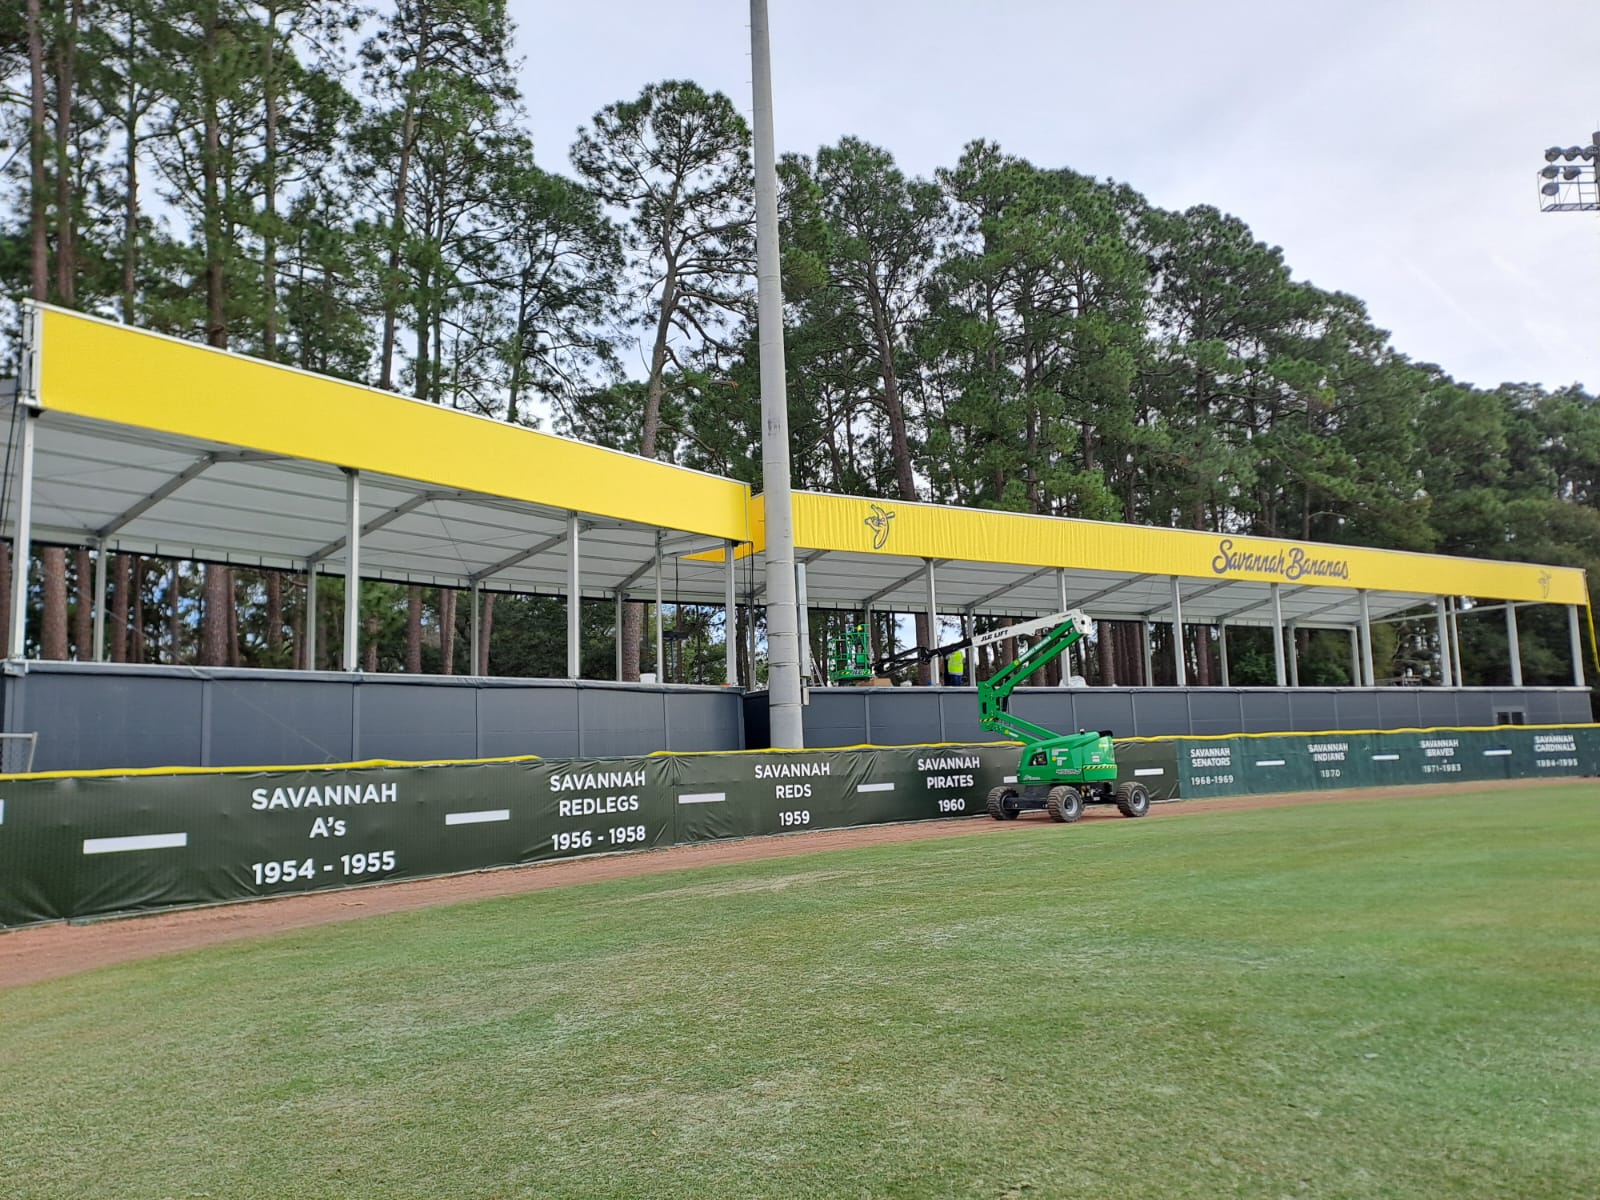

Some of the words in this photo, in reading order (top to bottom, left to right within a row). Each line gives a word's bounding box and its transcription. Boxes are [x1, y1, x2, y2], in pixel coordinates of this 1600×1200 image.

[1212, 539, 1286, 574] Savannah
[1285, 547, 1348, 580] Bananas
[1420, 739, 1459, 748] SAVANNAH
[1534, 735, 1574, 744] SAVANNAH
[1190, 747, 1231, 758] SAVANNAH
[1307, 742, 1348, 753] SAVANNAH
[1425, 748, 1454, 757] BRAVES
[1534, 743, 1576, 752] CARDINALS
[917, 756, 980, 771] SAVANNAH
[1191, 757, 1231, 768] SENATORS
[1313, 752, 1345, 761] INDIANS
[754, 762, 831, 779] SAVANNAH
[550, 771, 646, 792] SAVANNAH
[926, 774, 974, 789] PIRATES
[251, 782, 397, 810] SAVANNAH
[775, 783, 812, 799] REDS
[559, 795, 639, 817] REDLEGS
[938, 798, 965, 812] 1960
[778, 810, 810, 826] 1959
[309, 816, 346, 839] A's
[551, 831, 592, 851] 1956
[609, 825, 646, 844] 1958
[252, 858, 316, 885] 1954
[340, 850, 396, 875] 1955
